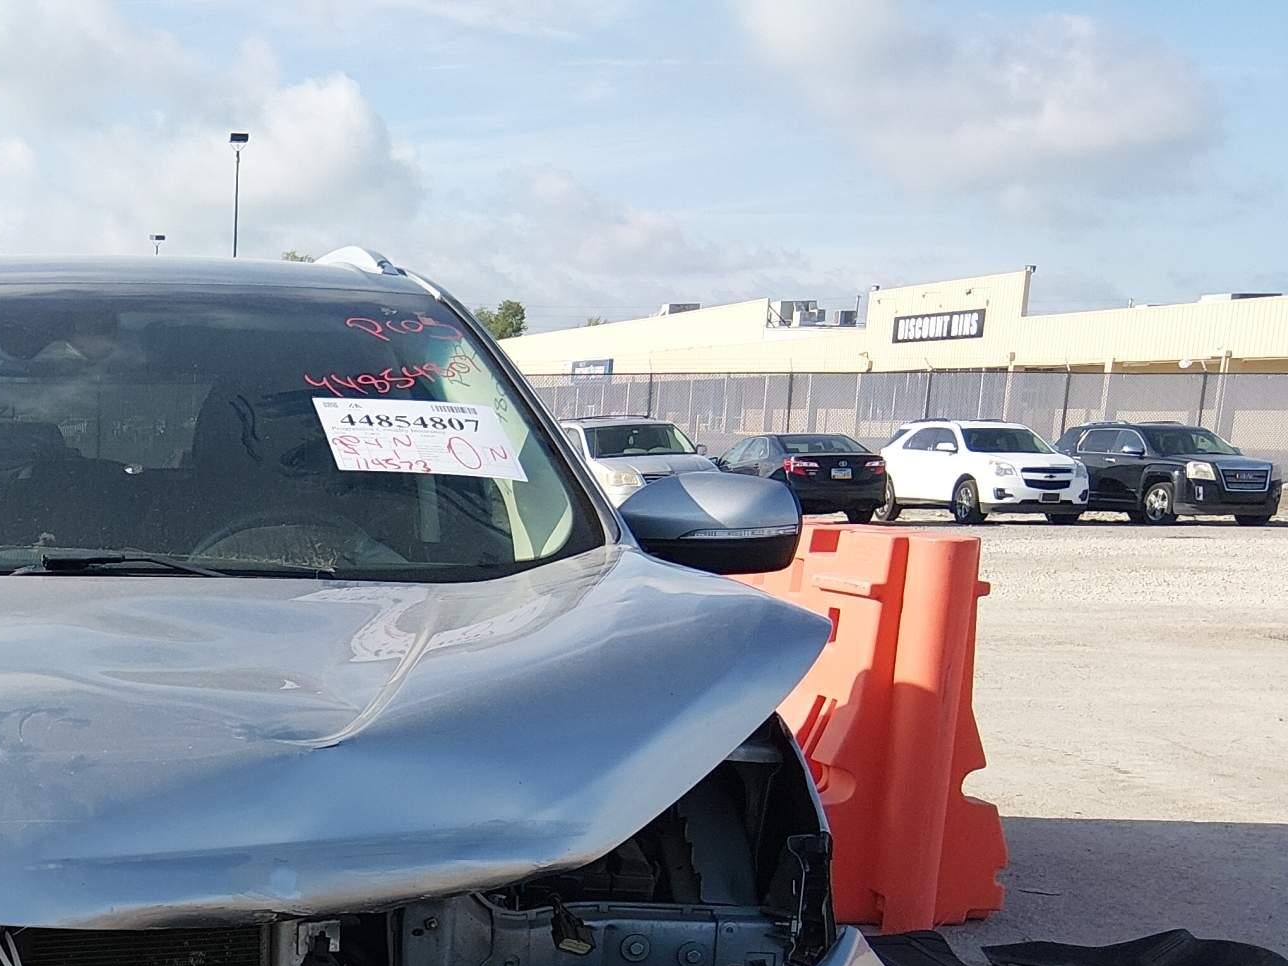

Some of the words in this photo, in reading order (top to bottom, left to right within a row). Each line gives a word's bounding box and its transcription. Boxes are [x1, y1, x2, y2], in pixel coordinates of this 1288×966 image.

[897, 315, 950, 341] DISCOUNT
[950, 312, 979, 337] BINS
[340, 413, 479, 432] 44854807
